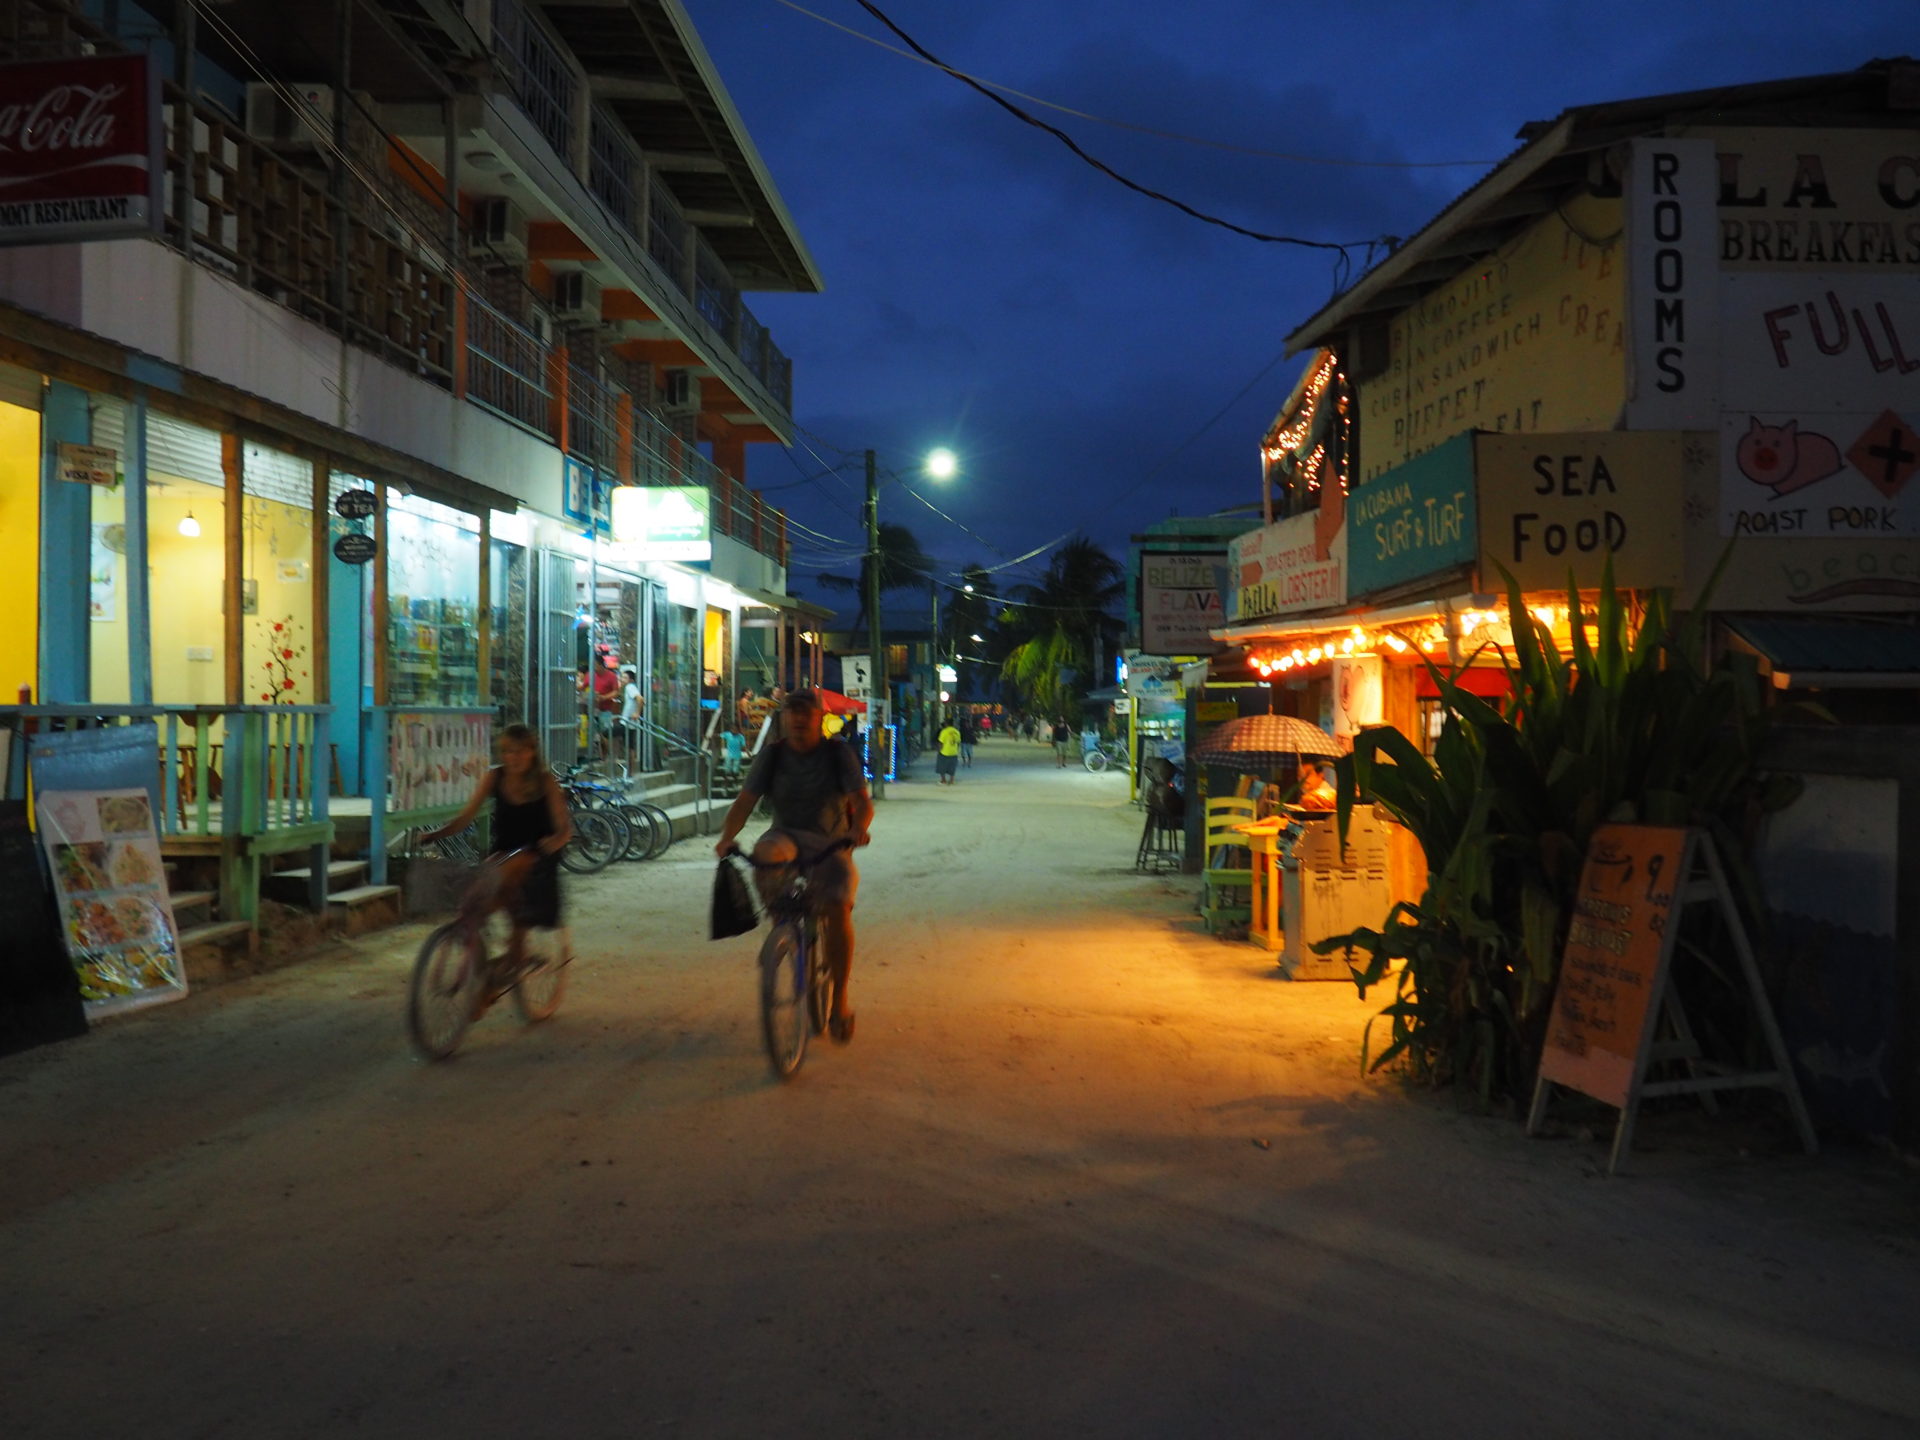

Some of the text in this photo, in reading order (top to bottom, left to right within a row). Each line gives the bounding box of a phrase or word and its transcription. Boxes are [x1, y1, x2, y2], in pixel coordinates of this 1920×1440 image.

[1716, 153, 1837, 208] LA
[35, 197, 129, 224] RESTAURANT
[1652, 153, 1685, 393] ROOMS
[1431, 312, 1542, 388] SANDWICH
[1763, 290, 1920, 375] FULL
[1533, 455, 1616, 496] SEA
[1367, 481, 1413, 519] CUBANA
[1736, 506, 1897, 534] ROAST PORK
[1376, 508, 1413, 560] SURF
[1424, 490, 1466, 547] TURF
[1512, 510, 1627, 562] FOOD
[1148, 567, 1212, 585] BELIZE
[1780, 551, 1920, 592] beac
[1159, 592, 1222, 611] FLAVA
